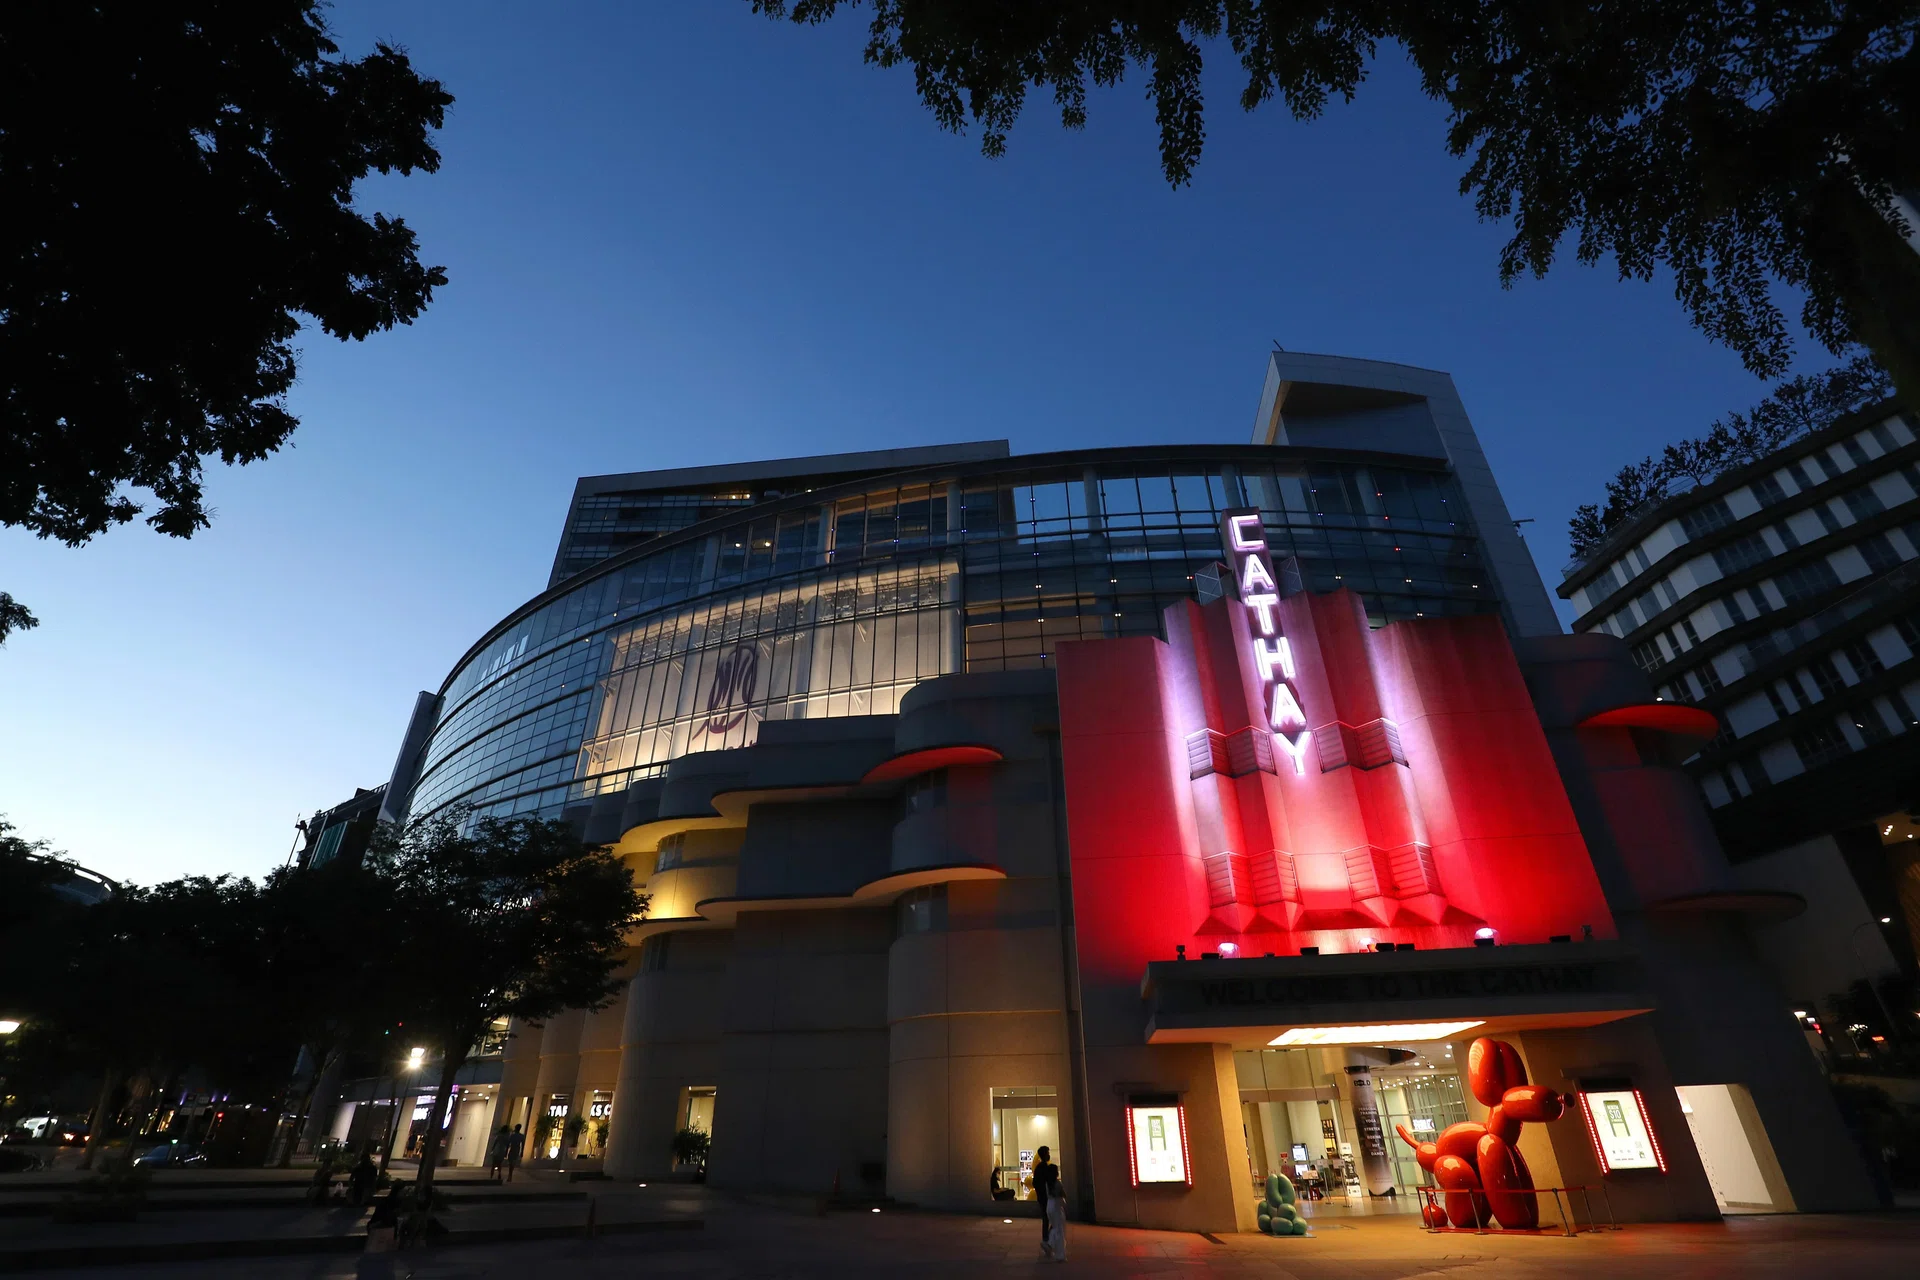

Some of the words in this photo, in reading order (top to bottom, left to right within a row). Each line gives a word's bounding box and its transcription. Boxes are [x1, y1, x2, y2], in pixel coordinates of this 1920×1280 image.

[1229, 514, 1312, 776] CATHAY
[1201, 976, 1349, 1006] WELCOME
[1364, 974, 1401, 999] TO
[1411, 970, 1472, 996] THE
[1479, 966, 1597, 994] CATHAY
[1609, 1110, 1622, 1119] $10
